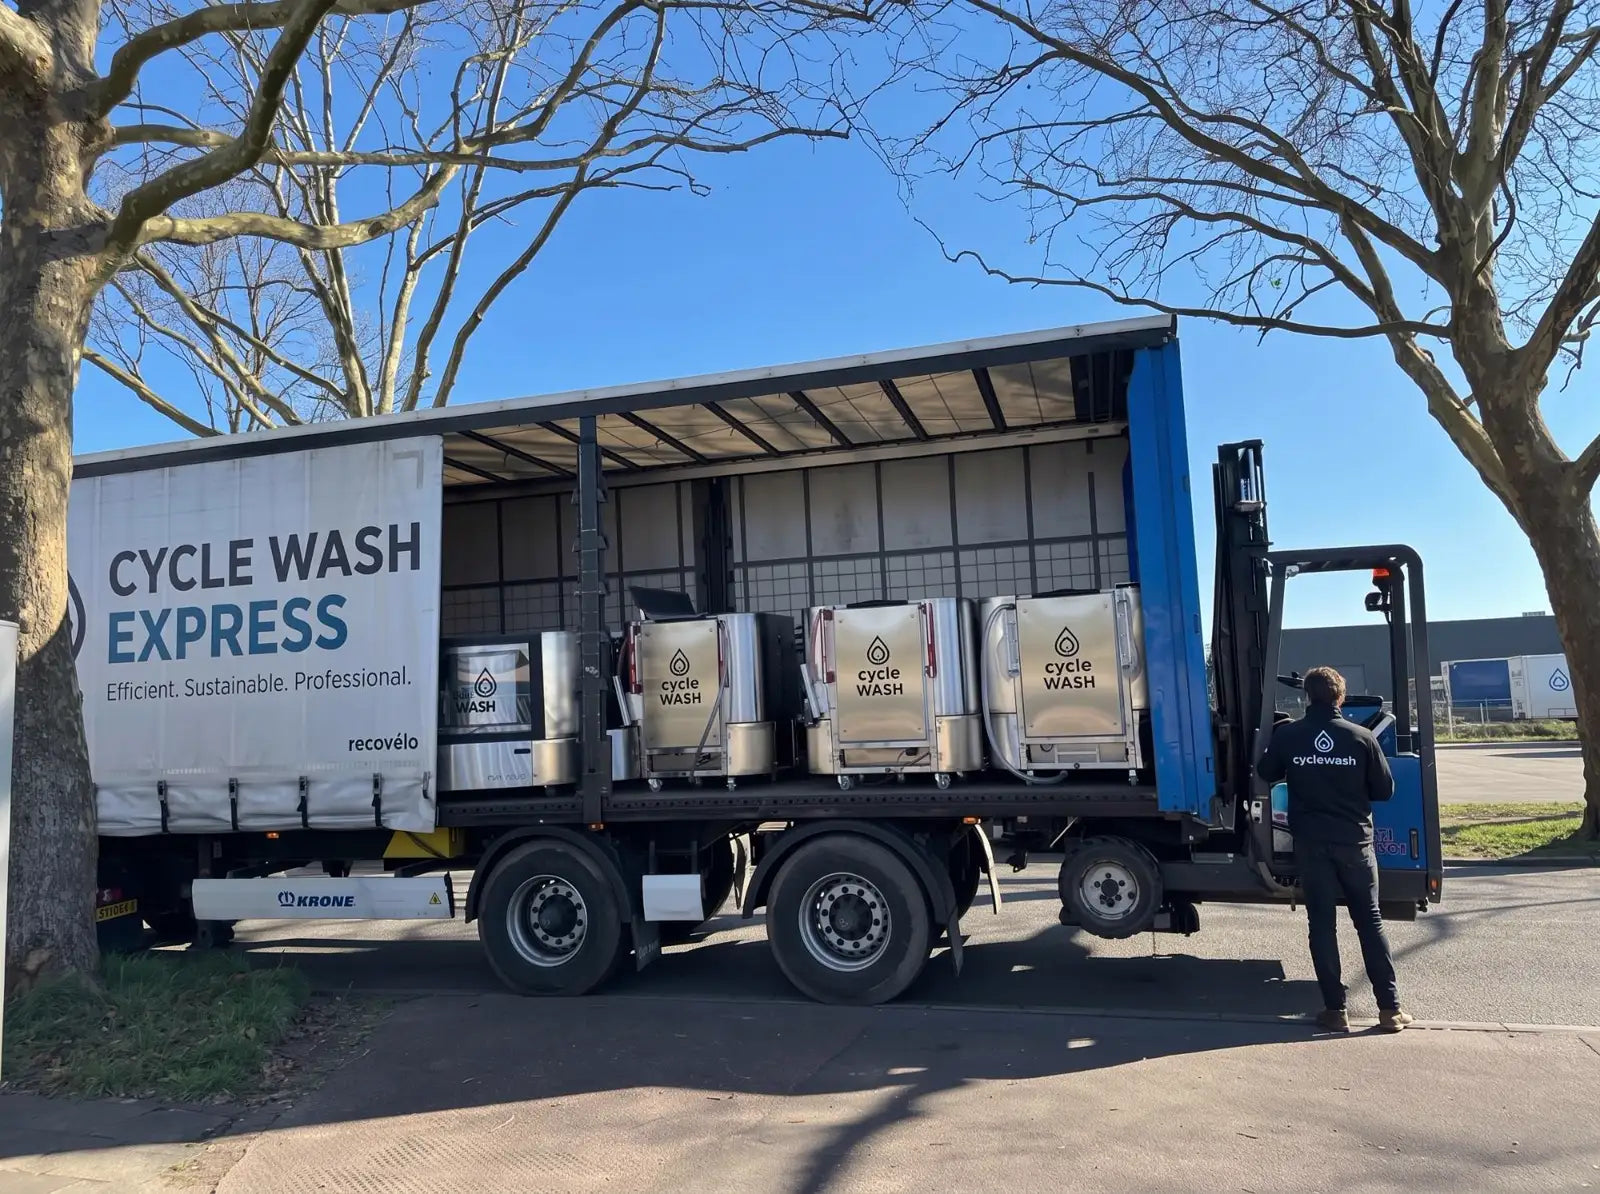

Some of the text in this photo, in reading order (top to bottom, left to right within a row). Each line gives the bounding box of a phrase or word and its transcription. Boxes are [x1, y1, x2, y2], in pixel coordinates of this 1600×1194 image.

[109, 522, 421, 597] CYCLE WASH
[108, 594, 348, 664] EXPRESS
[1045, 658, 1092, 675] cycle
[858, 667, 901, 682] cycle
[107, 665, 412, 701] Efficient. Sustainable. Professional.
[661, 677, 699, 693] cycle
[856, 682, 904, 697] WASH
[1043, 675, 1096, 690] WASH
[660, 692, 702, 706] WASH
[456, 700, 496, 714] WASH
[348, 733, 419, 752] recovélo
[1292, 754, 1357, 766] cyclewash
[297, 895, 356, 908] KRONE
